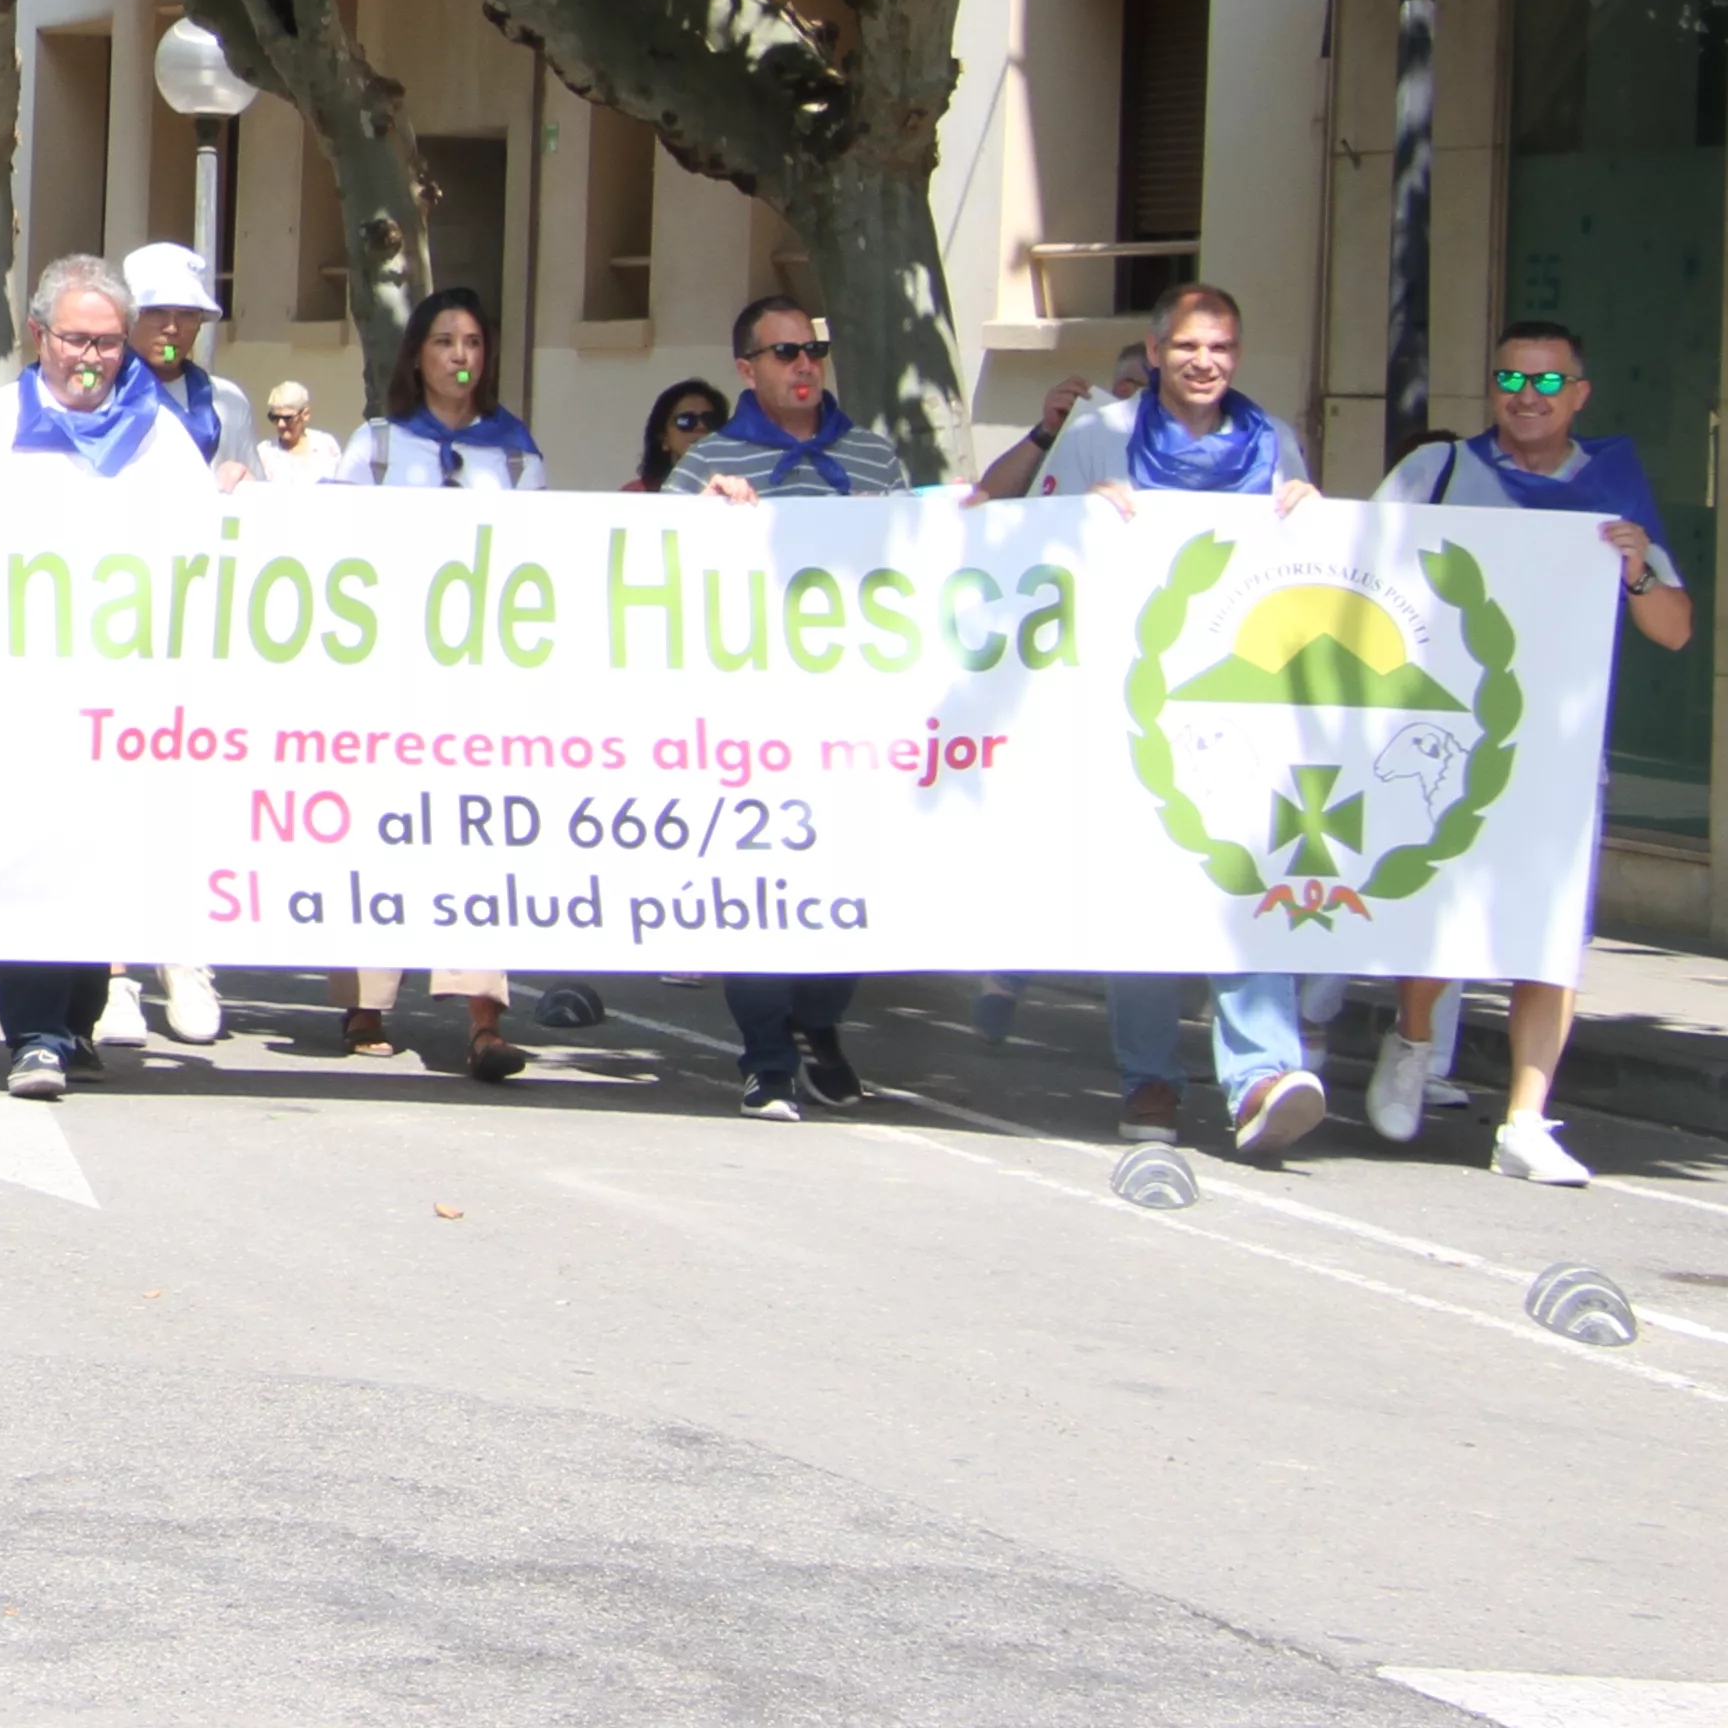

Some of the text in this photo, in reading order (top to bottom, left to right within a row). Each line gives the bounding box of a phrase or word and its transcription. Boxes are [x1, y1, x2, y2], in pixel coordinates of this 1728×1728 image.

[426, 525, 558, 669] de
[608, 528, 1082, 675] Huesca
[1326, 563, 1385, 591] SALUS
[1383, 585, 1431, 645] POPULI
[80, 705, 1010, 789] Todos merecemos algo mejor
[249, 788, 817, 858] NO al RD 666/23
[207, 868, 867, 945] SI a la salud pública
